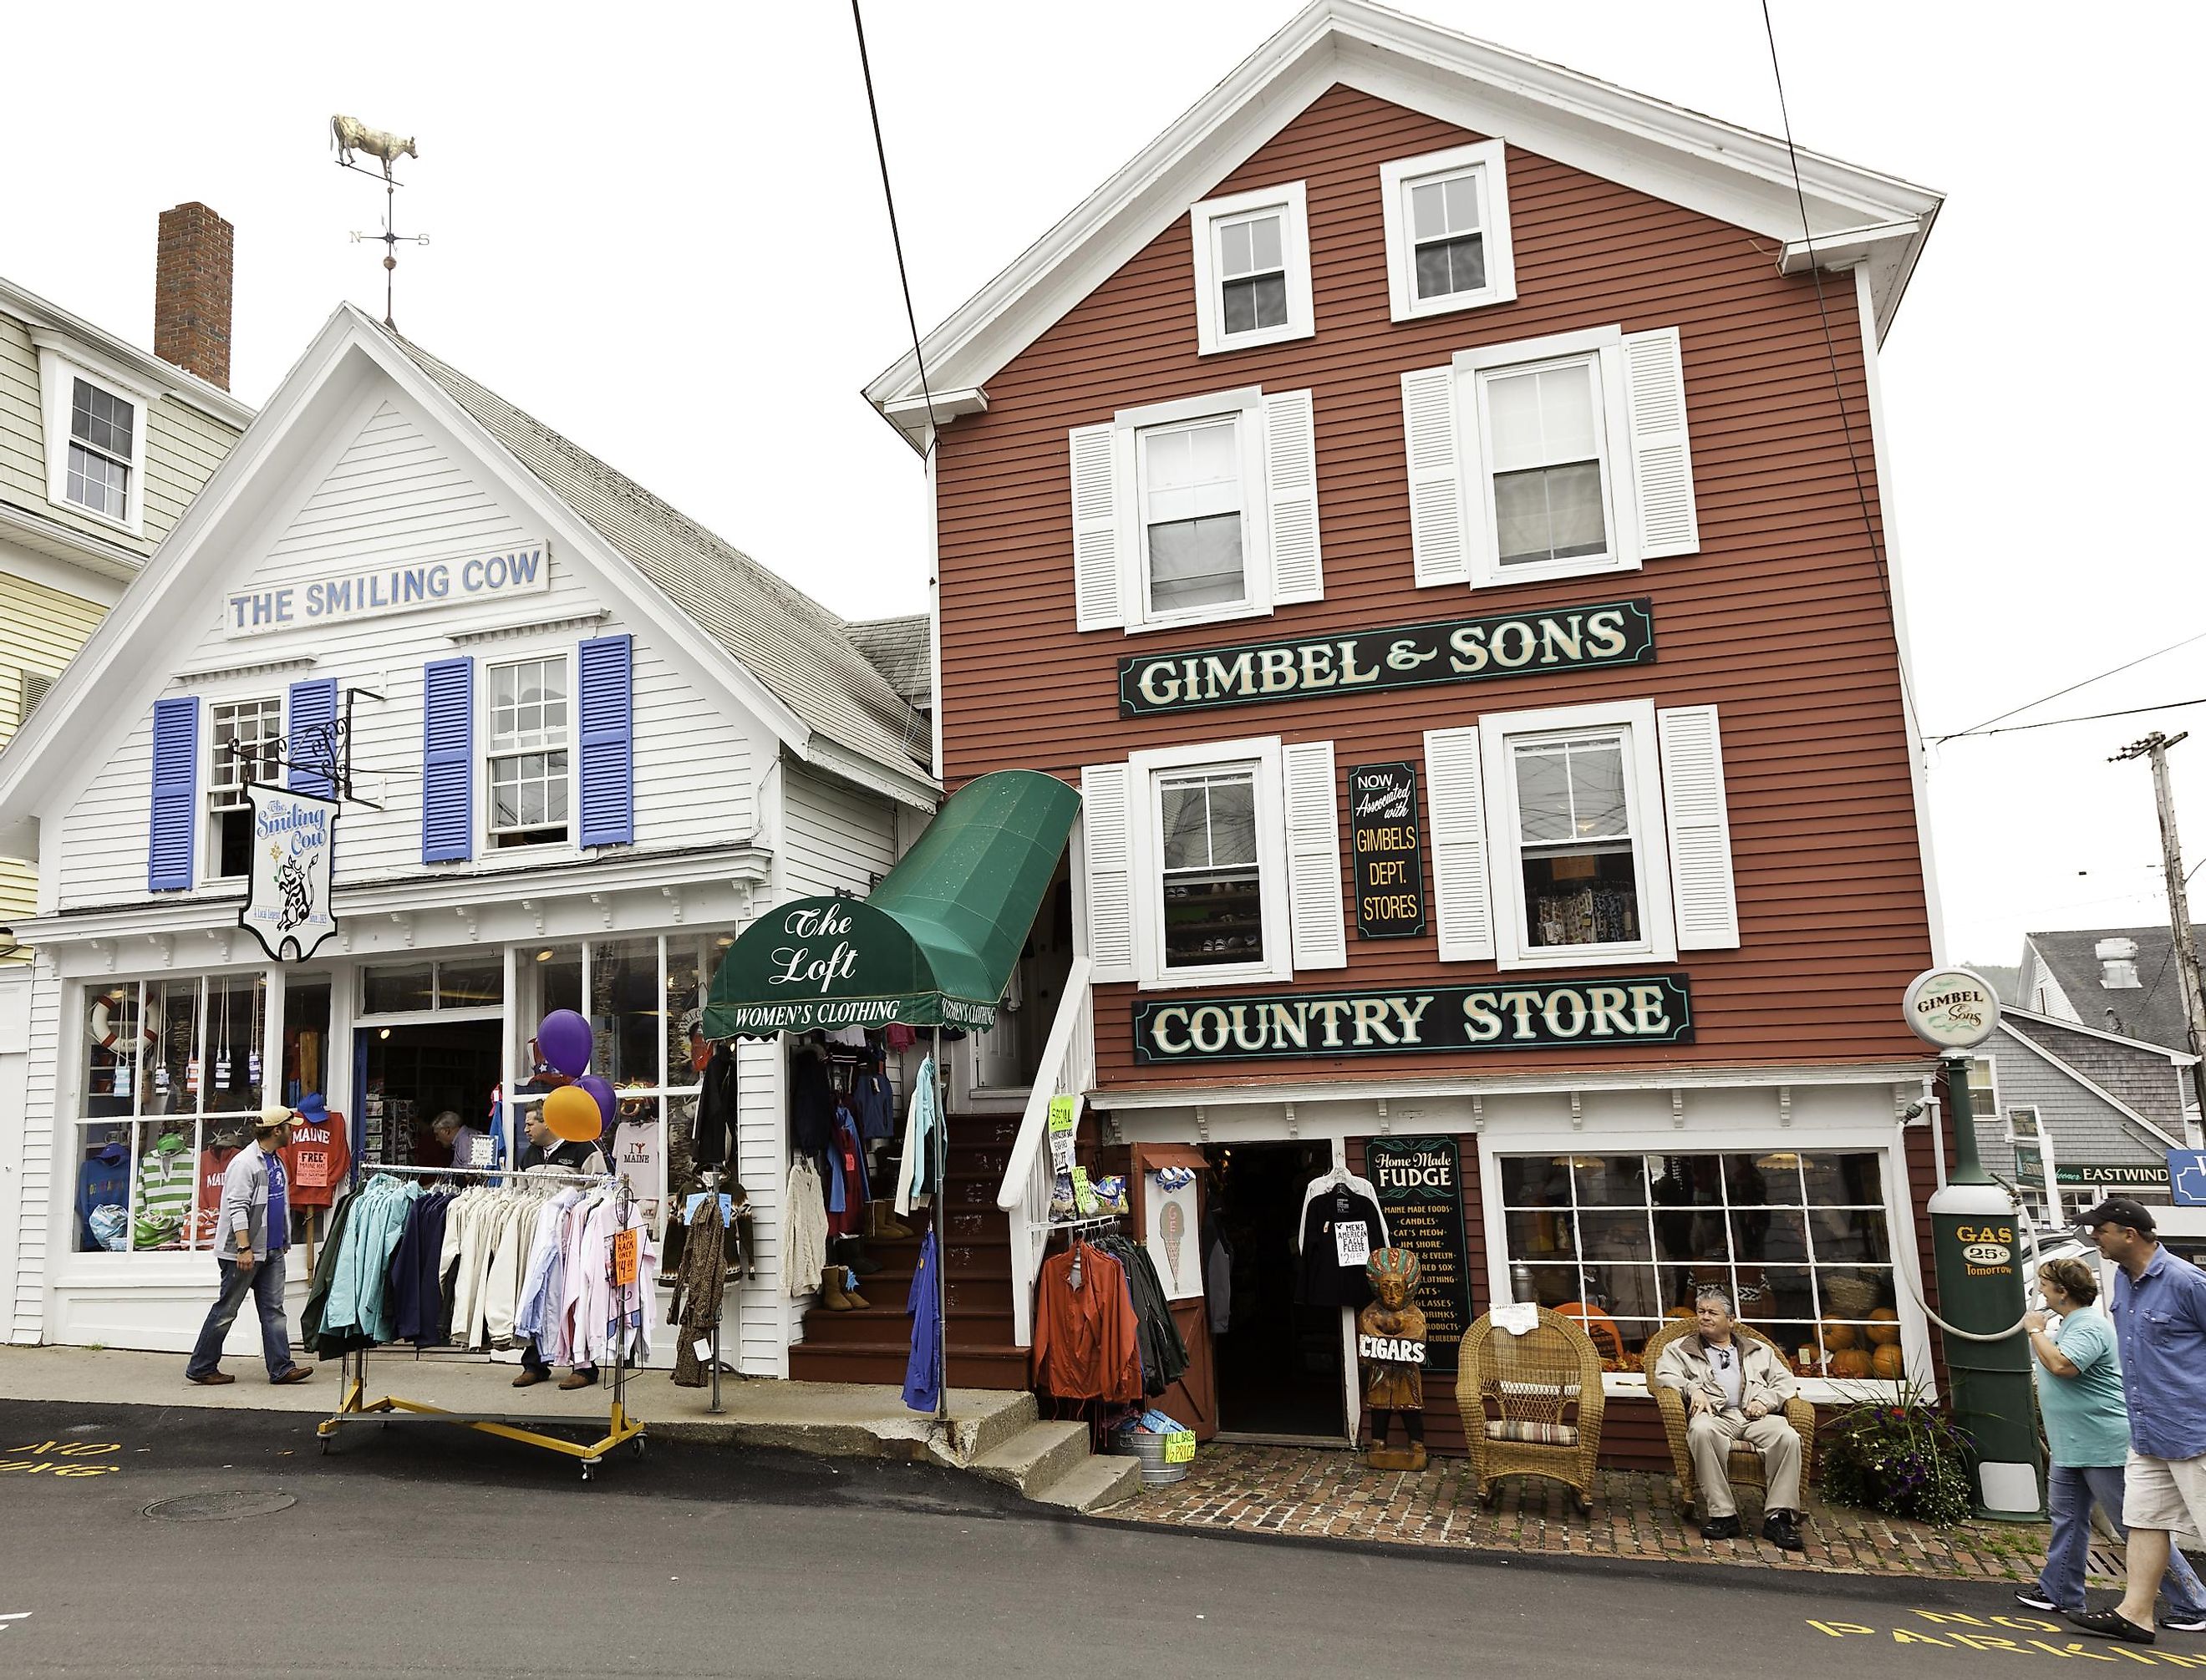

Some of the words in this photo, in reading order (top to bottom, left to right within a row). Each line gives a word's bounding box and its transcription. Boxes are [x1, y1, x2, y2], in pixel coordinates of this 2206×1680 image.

[229, 588, 294, 629] THE
[306, 564, 450, 617] SMILING
[461, 550, 541, 593] COW
[1137, 640, 1380, 706] GIMBEL
[1386, 638, 1438, 670] &
[1449, 609, 1628, 673] SONS
[1357, 773, 1393, 789] NOW
[268, 799, 287, 814] The
[1384, 798, 1410, 819] with
[257, 803, 325, 840] Smiling
[290, 828, 327, 857] Cow
[1356, 825, 1416, 853] GIMBELS
[1369, 860, 1407, 886] DEPT.
[1364, 894, 1418, 921] STORES
[784, 902, 852, 939] The
[768, 941, 859, 993] Loft
[1917, 991, 1984, 1013] GIMBEL
[734, 1003, 814, 1028] WOMEN'S
[816, 999, 901, 1024] CLOTHING
[1151, 995, 1435, 1054] COUNTRY
[1462, 985, 1670, 1043] STORE
[1948, 1003, 1982, 1027] Sons
[292, 1128, 331, 1145] MAINE
[302, 1152, 323, 1163] FREE
[623, 1154, 650, 1164] MAINE
[1375, 1153, 1411, 1168] Home
[1412, 1151, 1452, 1168] Made
[1379, 1167, 1452, 1187] FUDGE
[2082, 1168, 2170, 1182] EASTWIND
[1384, 1205, 1405, 1214] MAINE
[1407, 1205, 1426, 1214] MADE
[1427, 1205, 1450, 1213] FOODS
[1400, 1217, 1436, 1226] CANDLES
[617, 1231, 633, 1242] THIS
[1419, 1228, 1444, 1236] MEOW
[1956, 1226, 2013, 1244] GAS
[1400, 1241, 1414, 1249] JIM
[1416, 1241, 1441, 1249] SHORE
[1421, 1263, 1436, 1271] RED
[1438, 1263, 1453, 1271] SOX
[1965, 1262, 2012, 1276] Tomorrow
[1417, 1287, 1437, 1296] ATS
[1414, 1299, 1451, 1307] GLASSES
[1426, 1322, 1459, 1331] RODUCTS
[1360, 1335, 1426, 1363] CIGARS
[5, 1439, 122, 1456] NO
[1175, 1444, 1195, 1461] PRICE
[1906, 1608, 2061, 1633] NO
